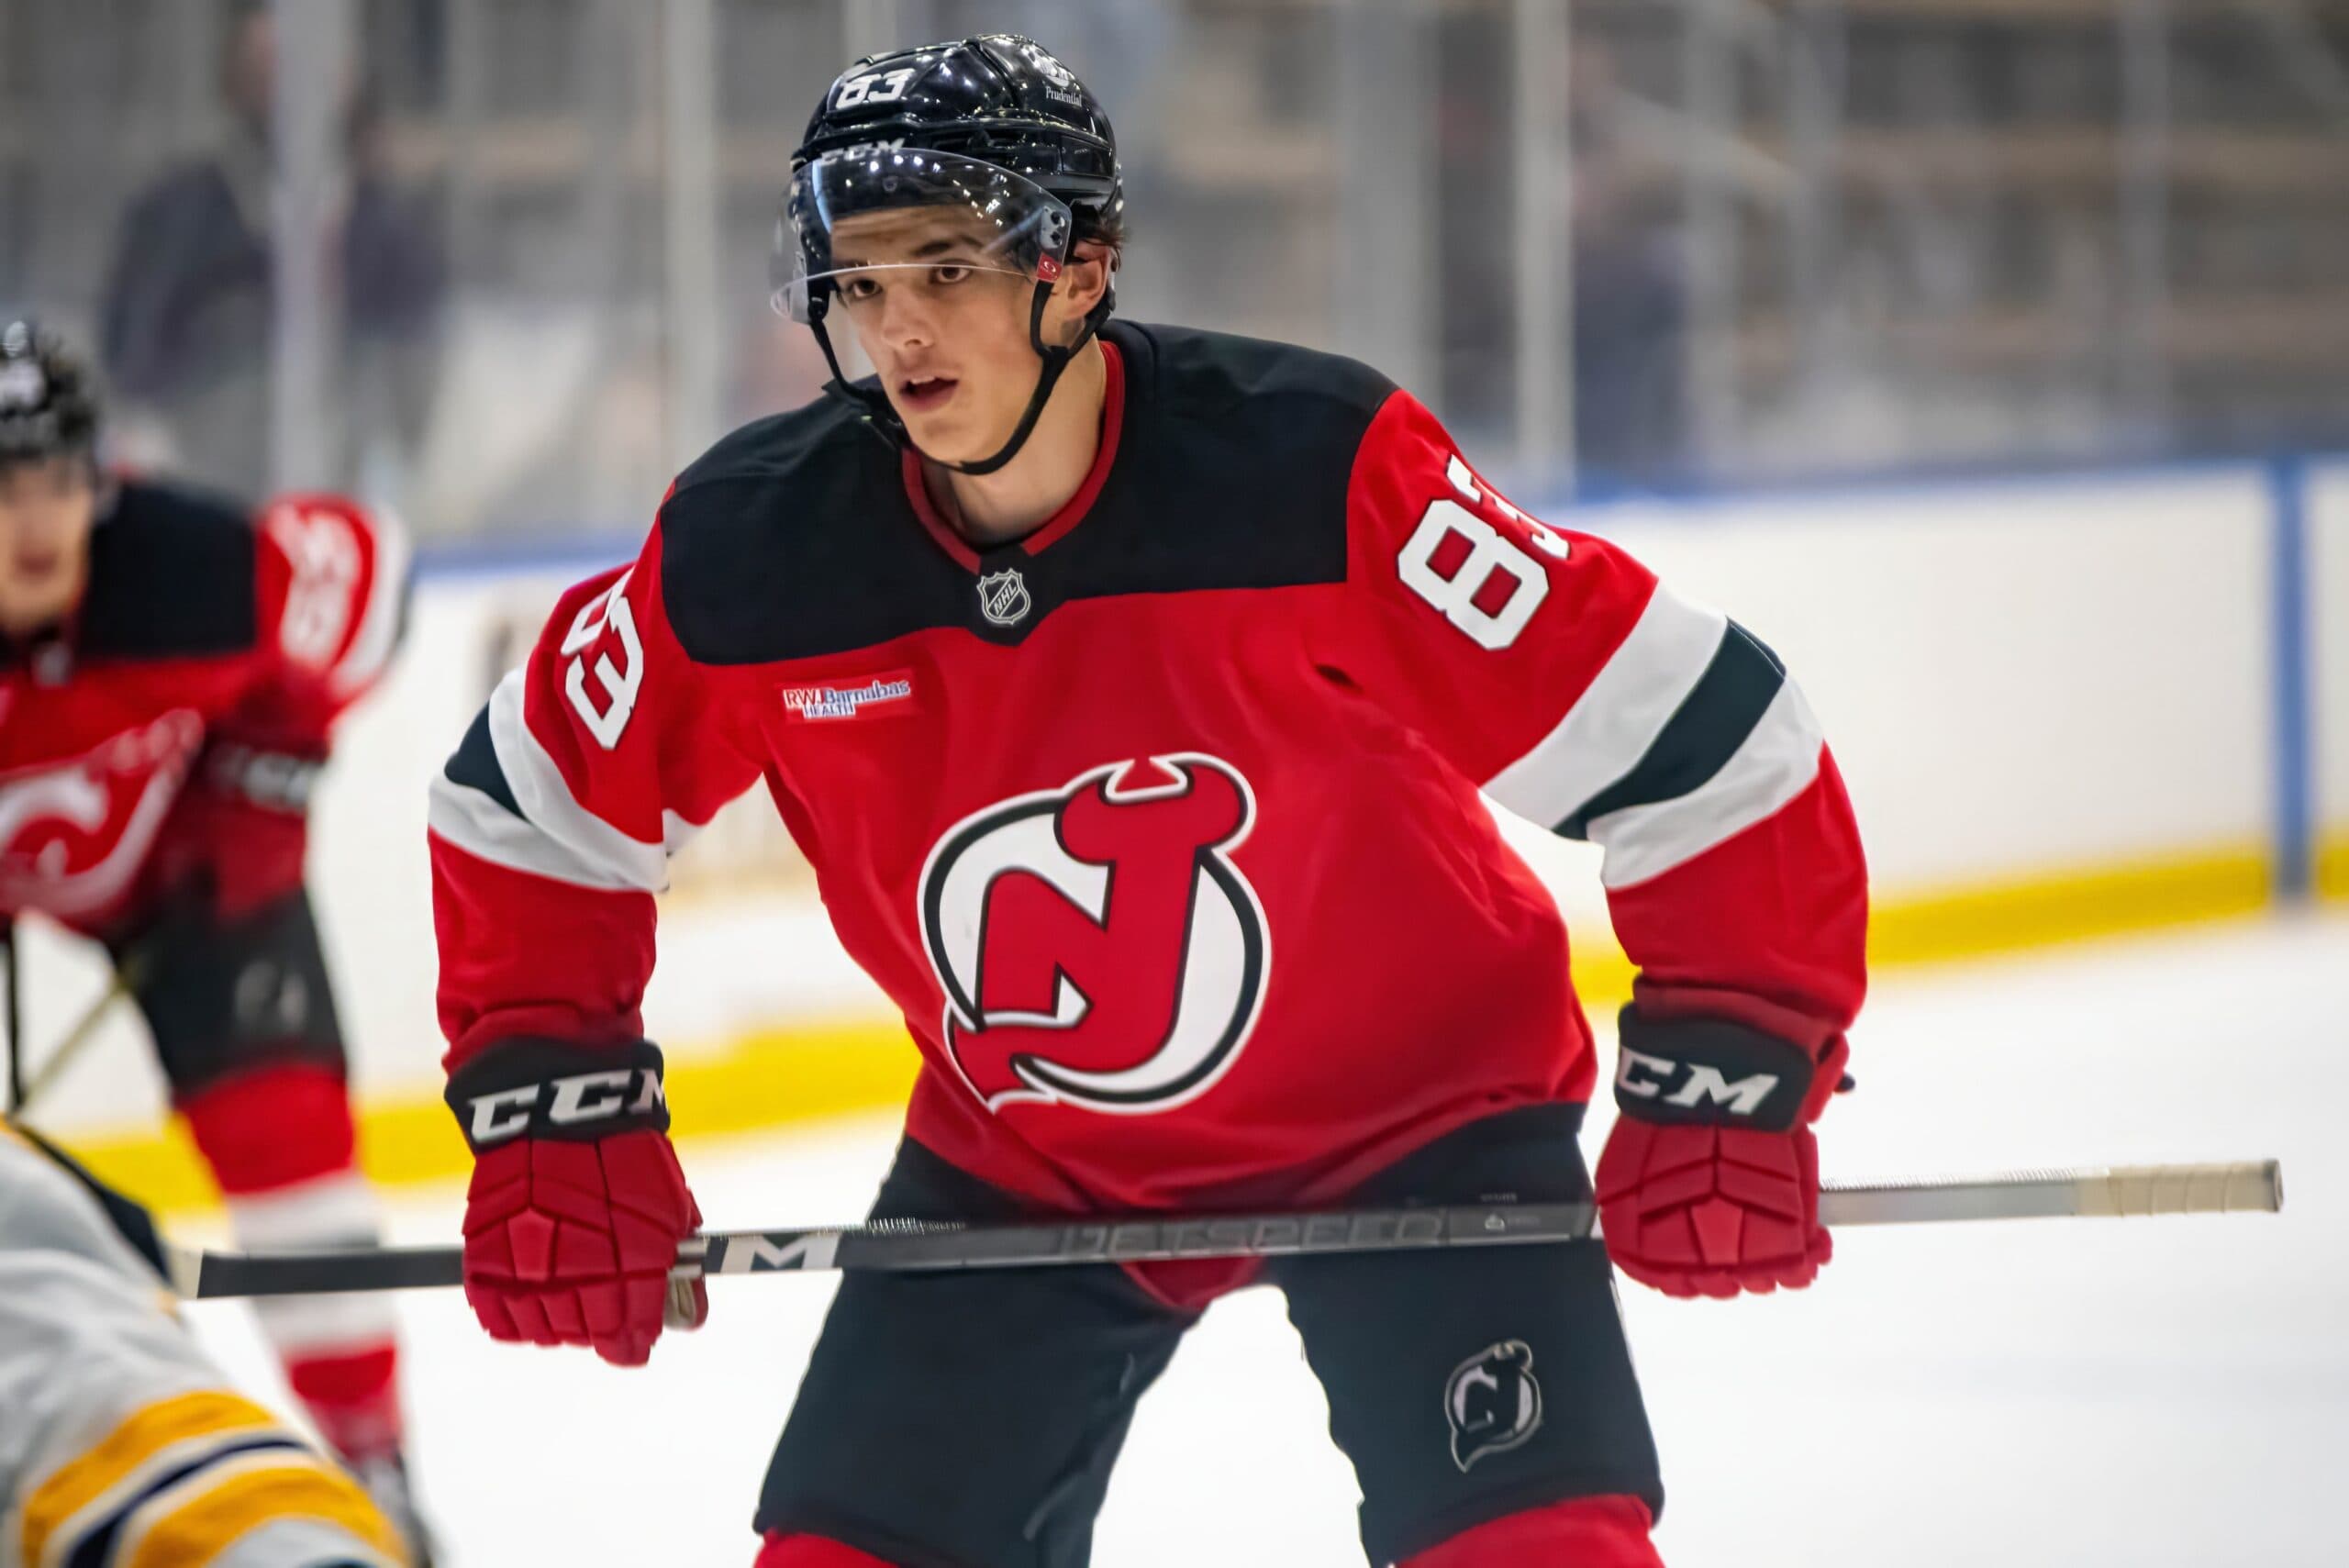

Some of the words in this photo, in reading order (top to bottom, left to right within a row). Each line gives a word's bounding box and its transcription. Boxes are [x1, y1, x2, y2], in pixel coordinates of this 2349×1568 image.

[835, 68, 916, 109] 83
[1045, 86, 1083, 107] Prudential
[993, 582, 1018, 617] NHL
